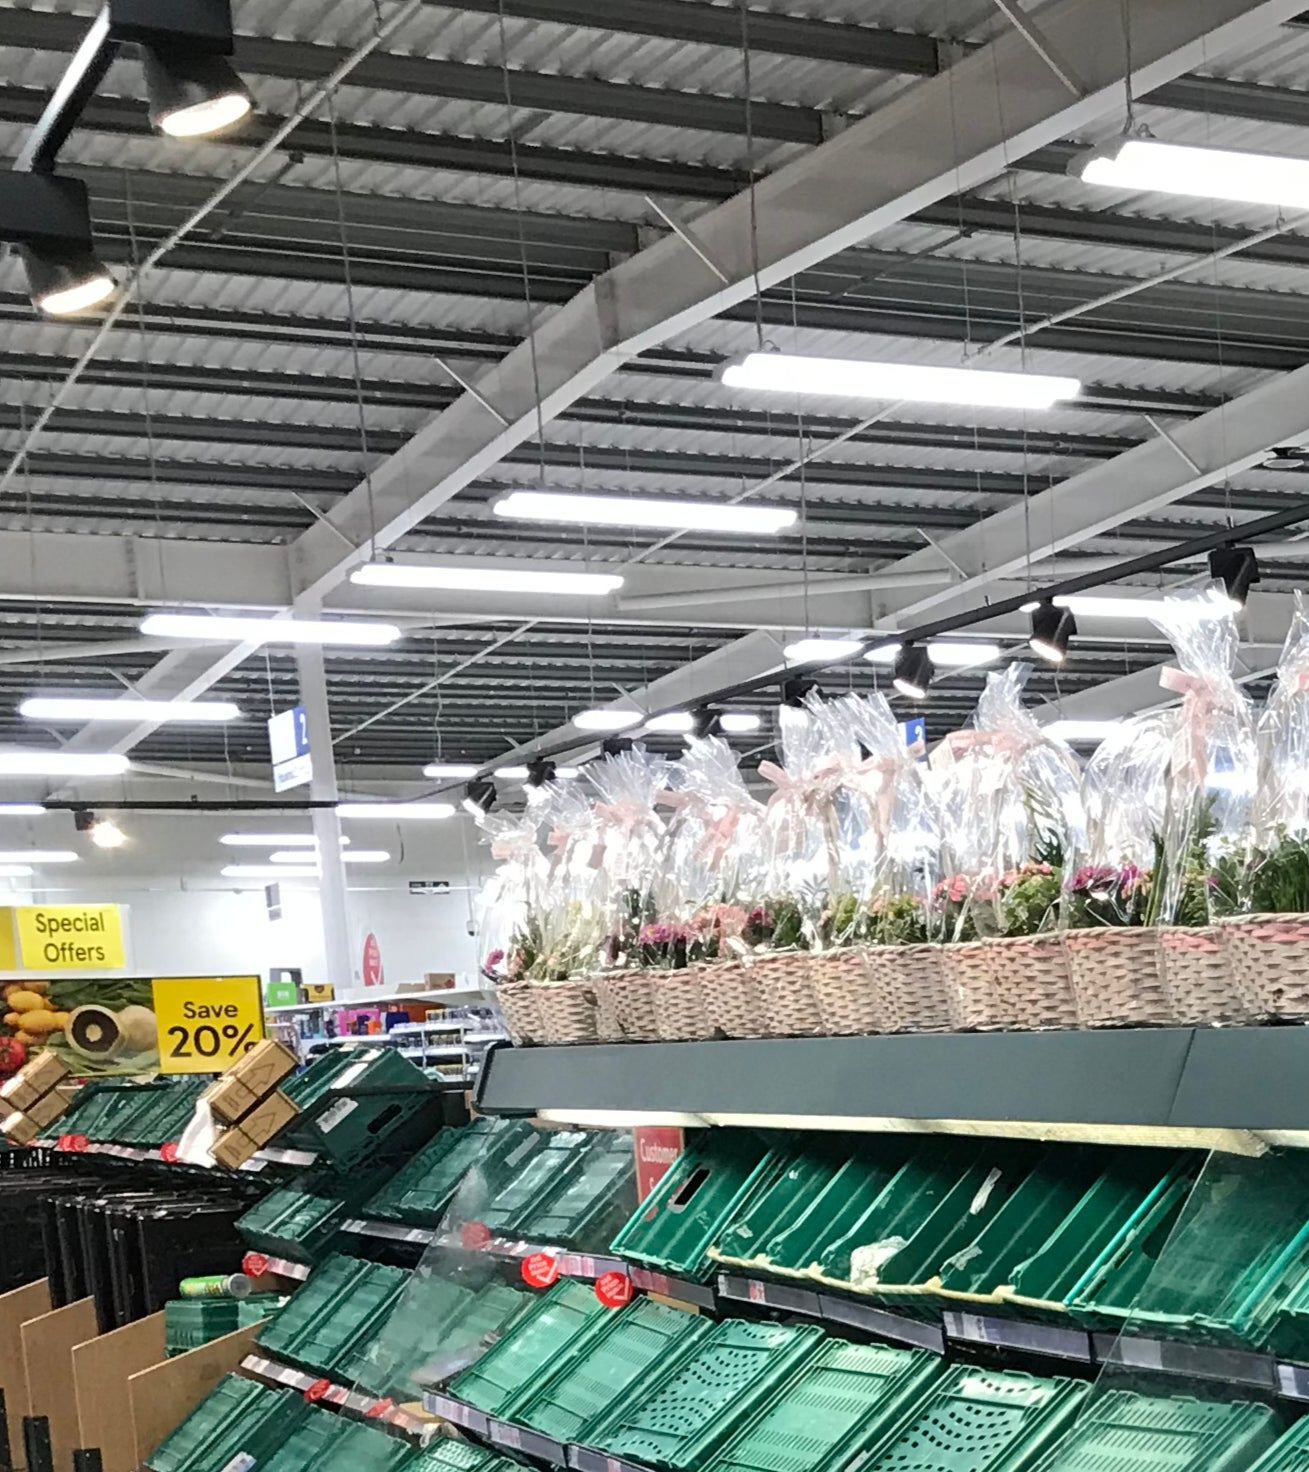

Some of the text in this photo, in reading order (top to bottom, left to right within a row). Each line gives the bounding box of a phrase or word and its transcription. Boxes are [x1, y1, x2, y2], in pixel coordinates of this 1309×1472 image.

[35, 912, 105, 938] Special
[43, 943, 105, 963] Offers
[183, 1001, 239, 1019] Save
[167, 1022, 257, 1058] 20%
